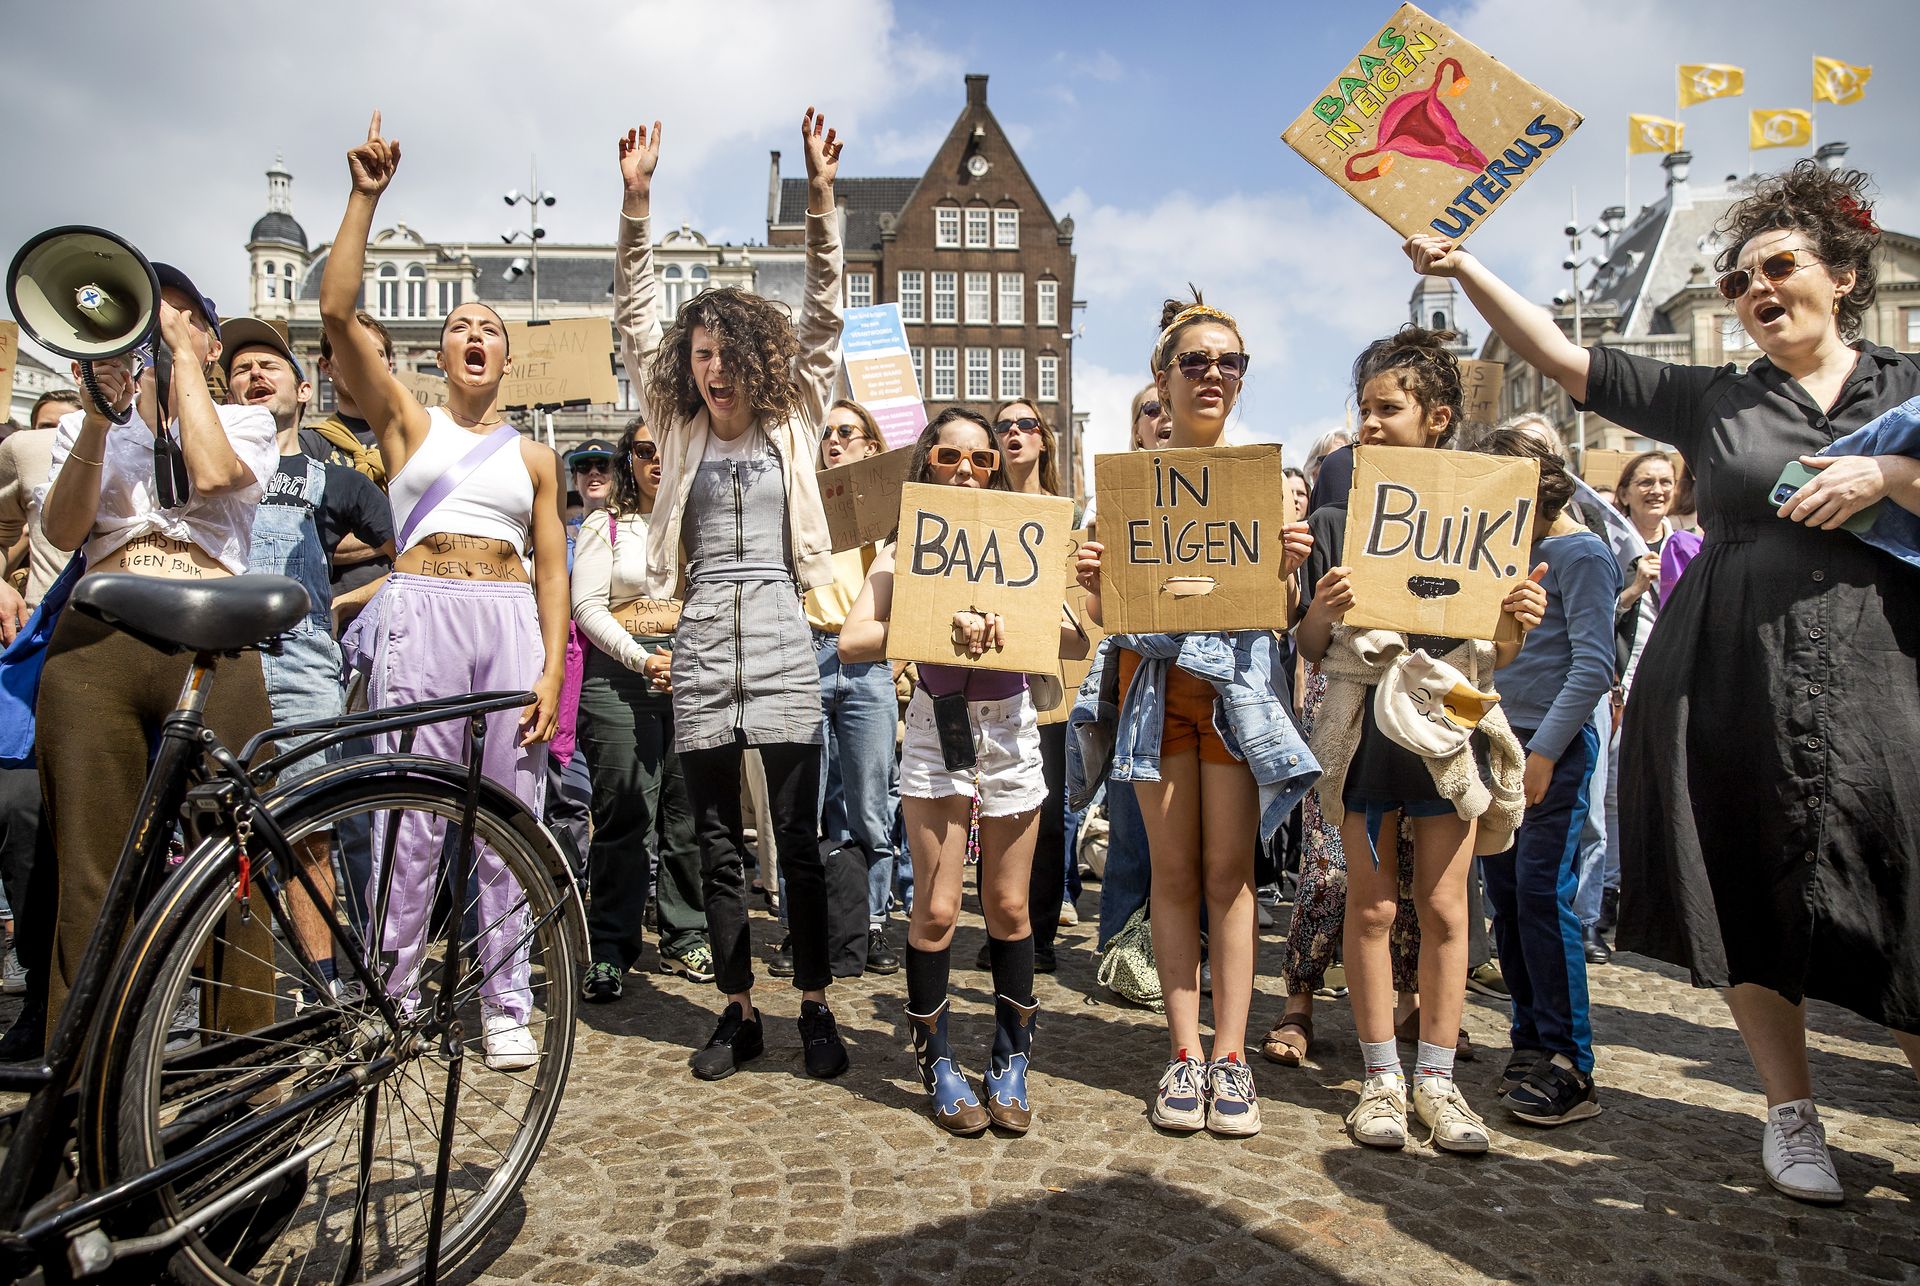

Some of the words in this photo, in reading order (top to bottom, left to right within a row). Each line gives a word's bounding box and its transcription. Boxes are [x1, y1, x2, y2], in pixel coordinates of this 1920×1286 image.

[1313, 27, 1405, 125] BAAS
[1325, 115, 1364, 151] IN
[1353, 32, 1437, 118] EIGEN
[1430, 114, 1564, 238] UTERUS
[510, 361, 551, 378] NIET
[911, 509, 1045, 588] BAAS
[120, 555, 165, 568] EIGEN
[172, 558, 202, 579] BUIK
[420, 560, 470, 576] EIGEN
[633, 599, 681, 616] BAAS
[625, 619, 665, 635] EIGEN
